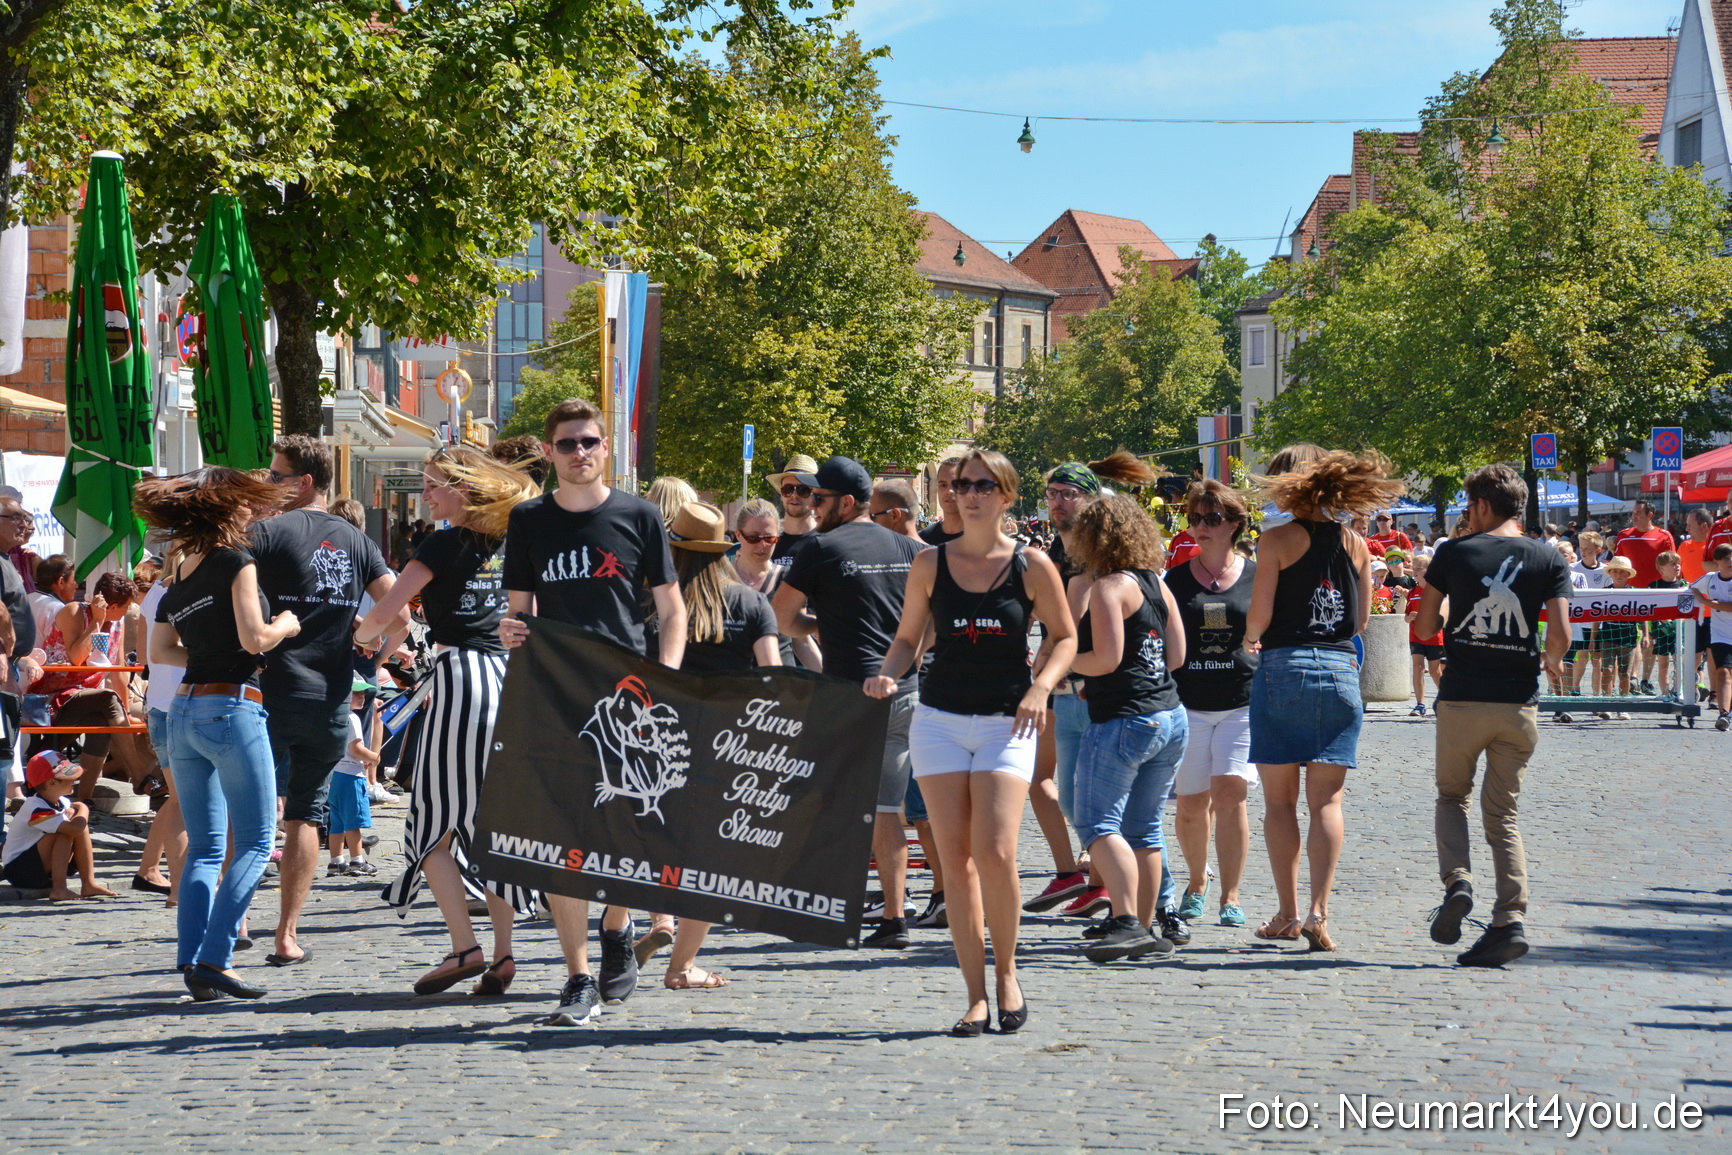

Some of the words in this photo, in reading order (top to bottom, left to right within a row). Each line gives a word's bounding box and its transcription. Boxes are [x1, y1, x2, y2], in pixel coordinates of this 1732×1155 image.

[745, 429, 752, 456] P
[1534, 457, 1555, 466] TAXI
[1654, 457, 1679, 467] TAXI
[387, 479, 404, 487] NZ
[465, 580, 493, 590] Salsa
[1590, 600, 1658, 617] Siedler
[1204, 659, 1235, 670] führe!
[736, 697, 803, 737] Kurse
[712, 729, 816, 783] Worskhops
[723, 771, 791, 818] Partys
[718, 808, 784, 848] Shows
[489, 831, 847, 919] WWW.SALSA-NEUMARKT.DE
